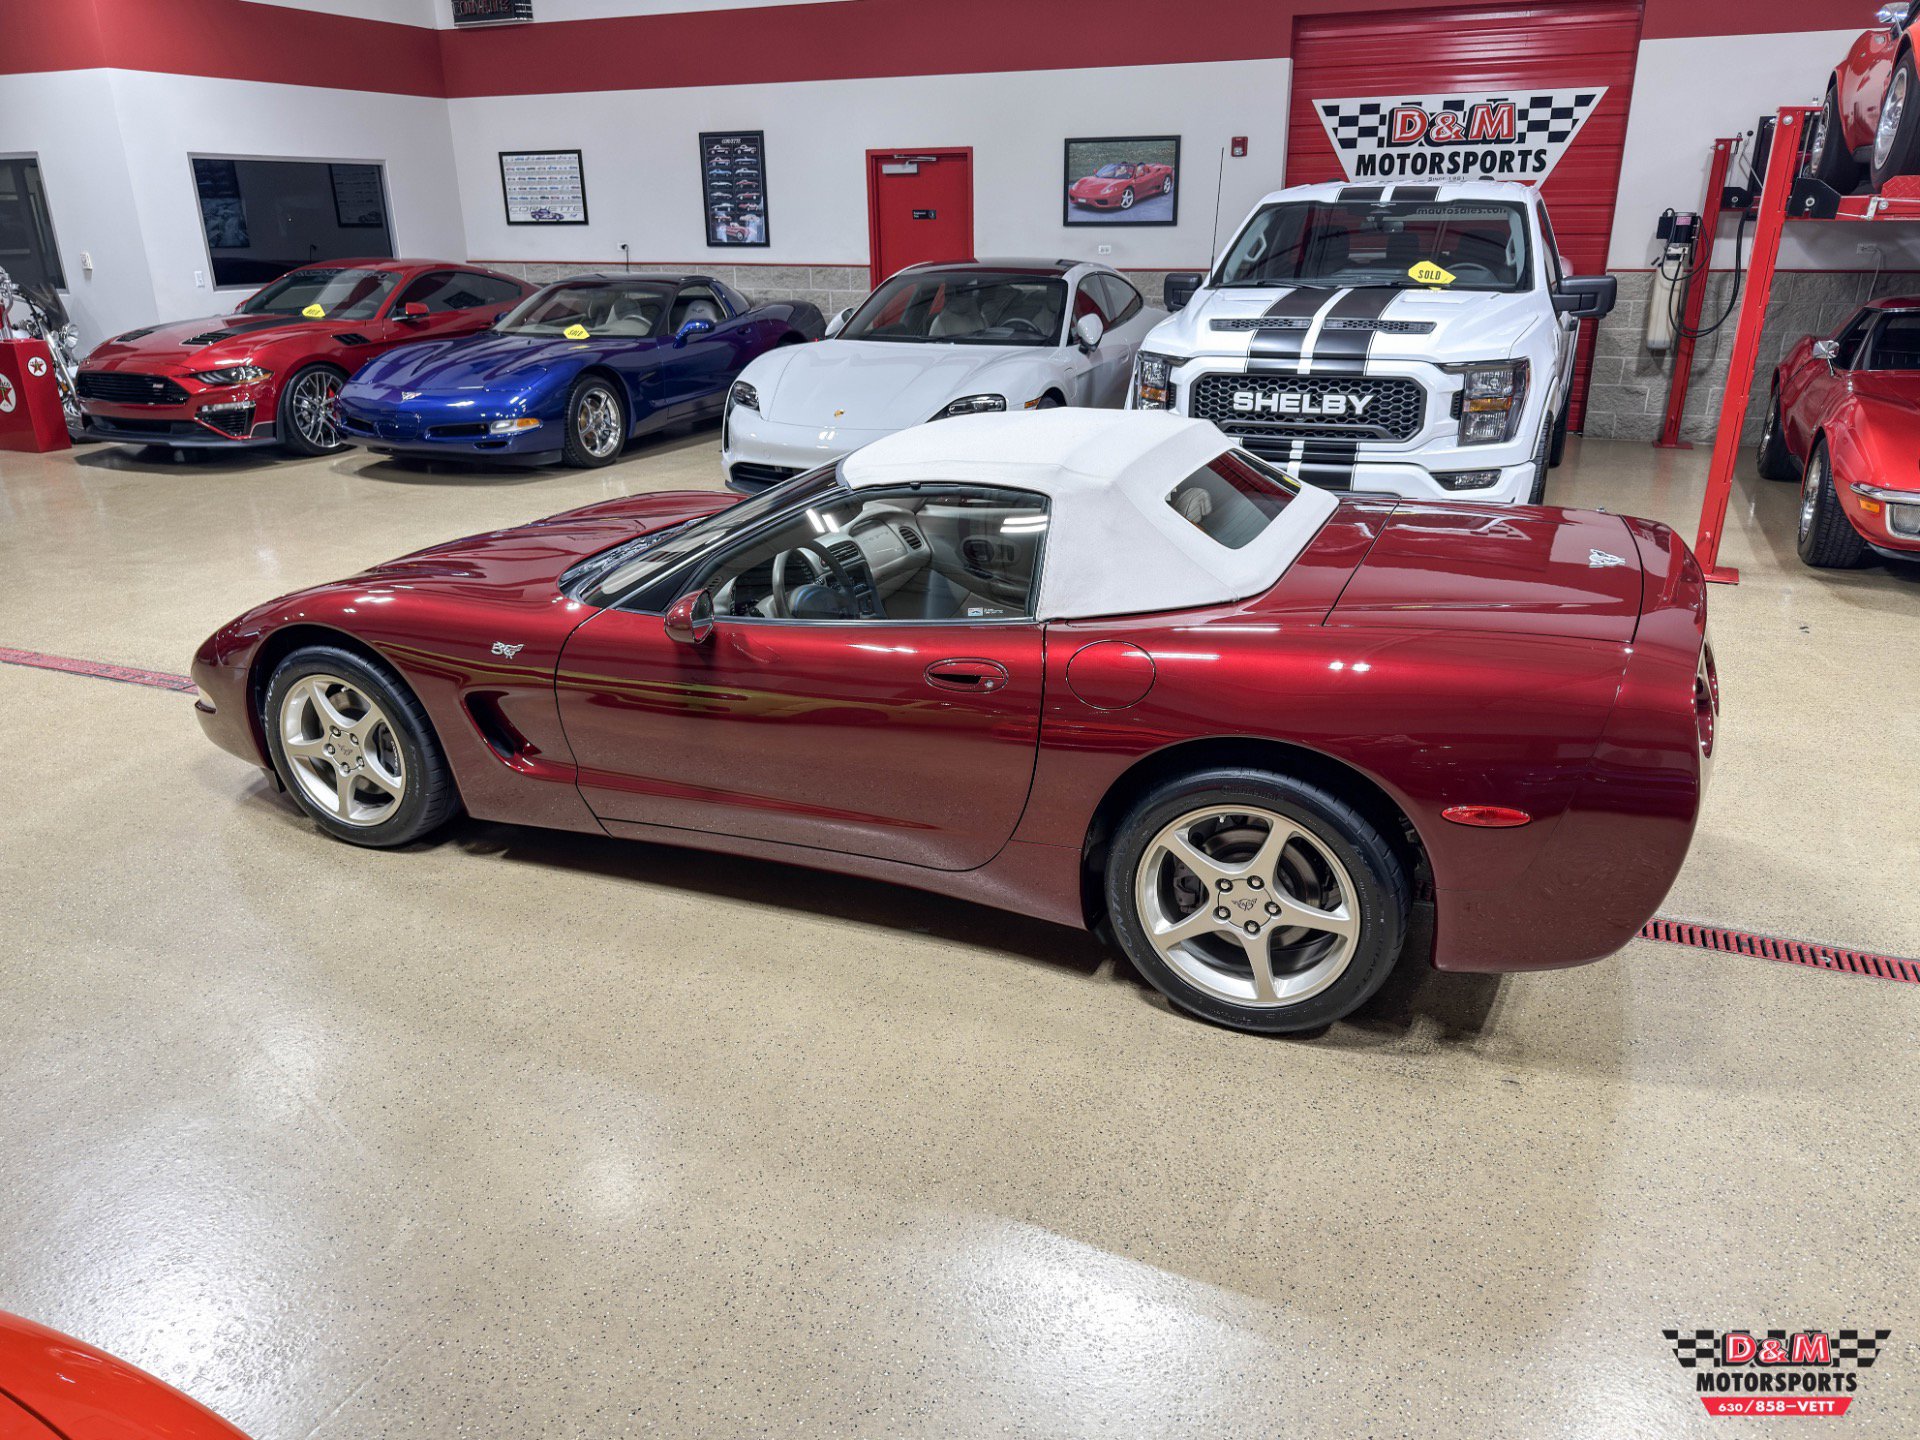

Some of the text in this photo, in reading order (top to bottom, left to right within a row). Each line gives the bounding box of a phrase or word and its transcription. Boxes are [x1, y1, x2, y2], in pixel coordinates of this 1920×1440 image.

[1387, 103, 1517, 147] D&M
[1355, 149, 1547, 176] MOTORSPORTS
[1417, 269, 1442, 281] SOLD
[1233, 391, 1374, 415] SHELBY
